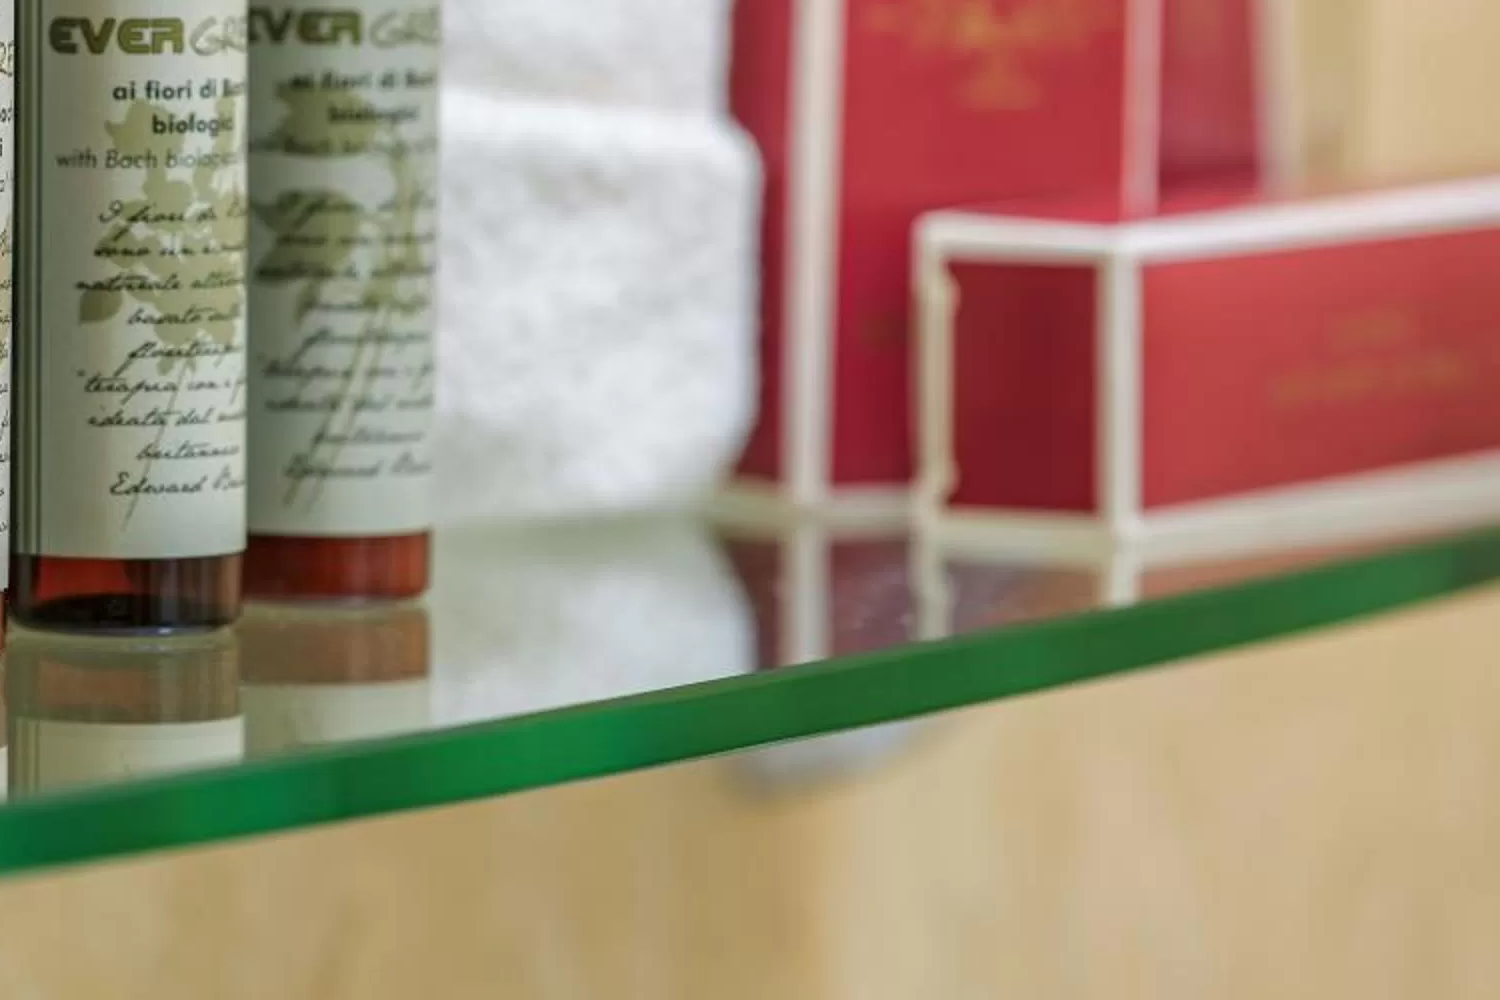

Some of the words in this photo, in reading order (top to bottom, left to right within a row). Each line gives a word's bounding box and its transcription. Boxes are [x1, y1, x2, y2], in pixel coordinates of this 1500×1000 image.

[48, 16, 185, 55] EVER
[112, 81, 137, 102] ai
[145, 80, 193, 101] fiori
